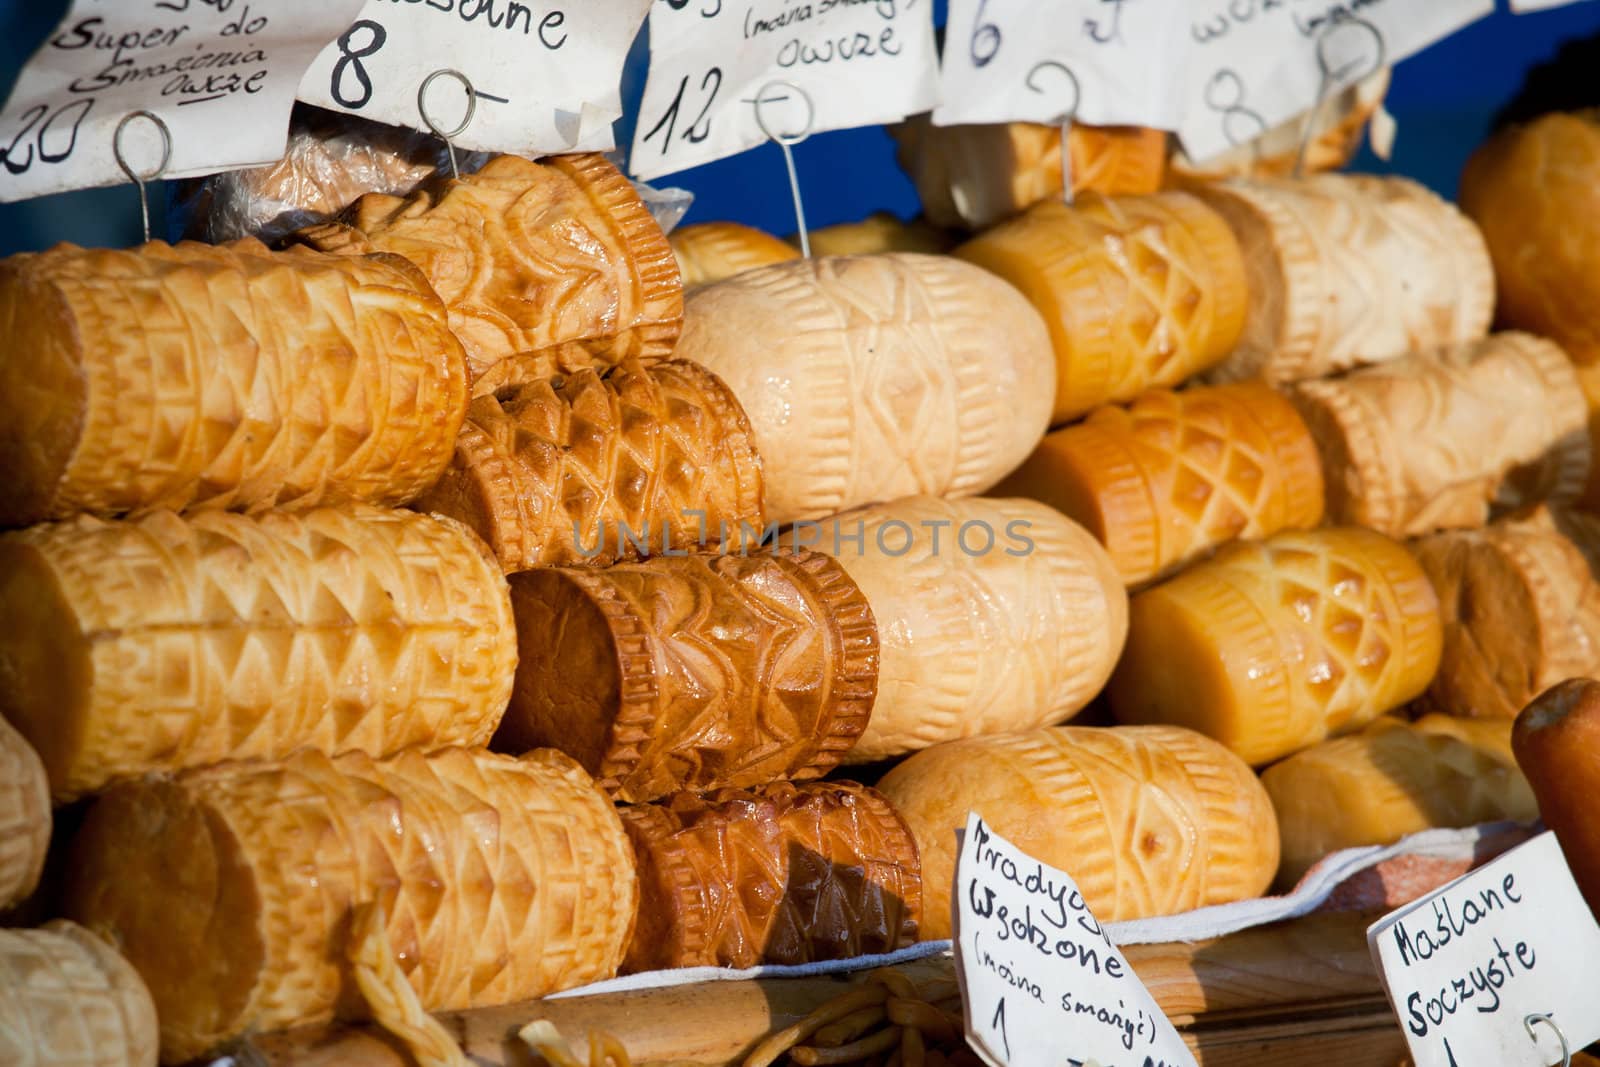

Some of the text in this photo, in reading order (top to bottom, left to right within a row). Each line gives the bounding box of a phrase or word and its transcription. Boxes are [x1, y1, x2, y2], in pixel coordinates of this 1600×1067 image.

[51, 6, 268, 66] Super do
[331, 19, 387, 109] 8
[0, 98, 95, 175] 20
[643, 67, 722, 155] 12
[1393, 873, 1522, 967] Maślane
[1407, 937, 1536, 1038] Soczyste
